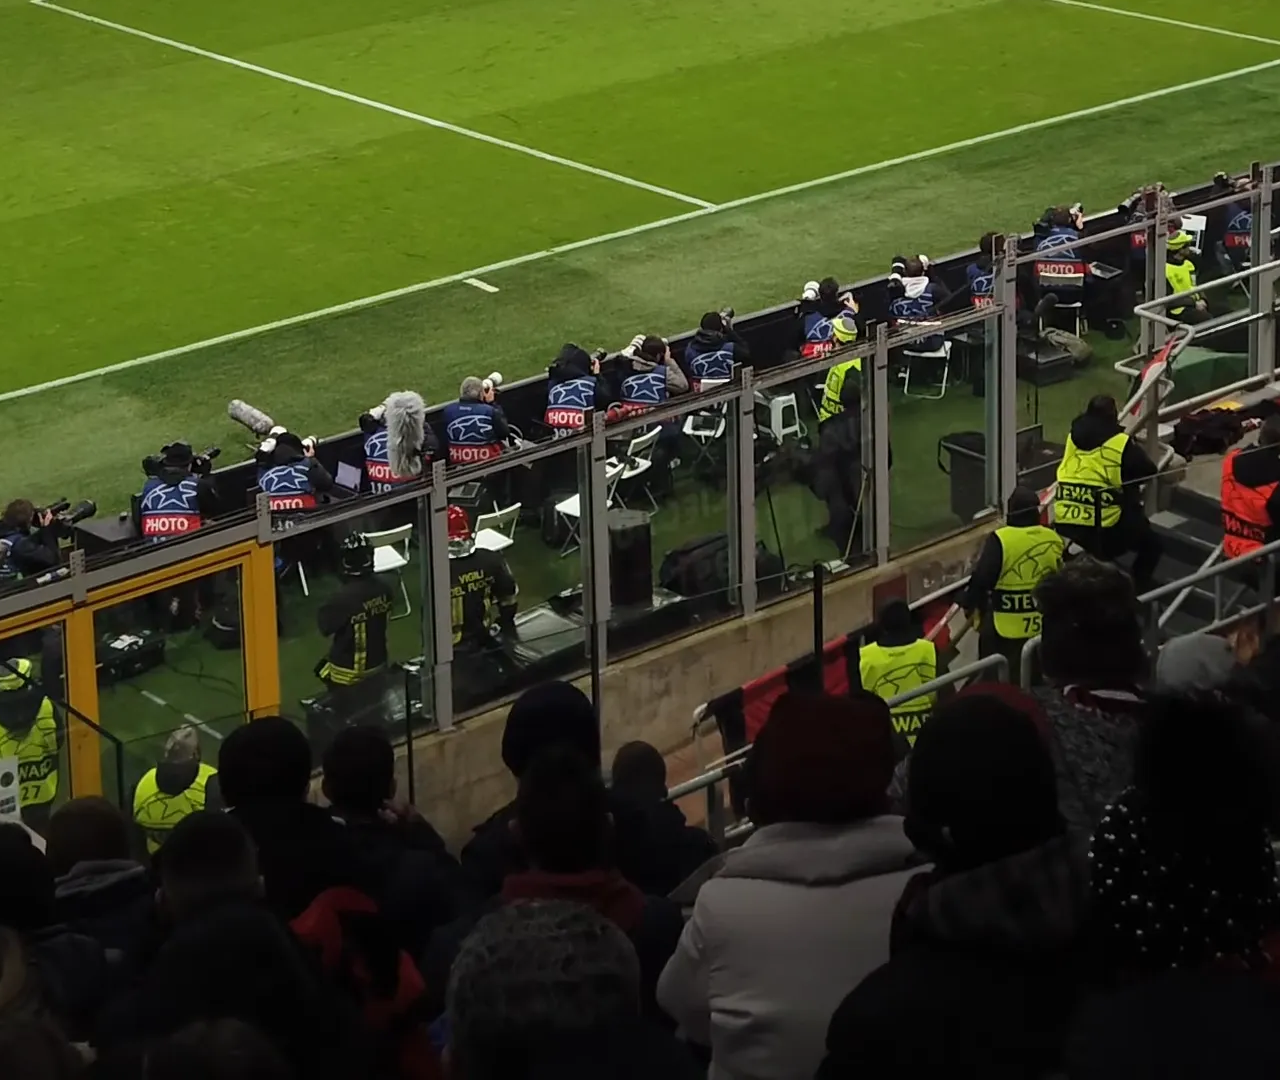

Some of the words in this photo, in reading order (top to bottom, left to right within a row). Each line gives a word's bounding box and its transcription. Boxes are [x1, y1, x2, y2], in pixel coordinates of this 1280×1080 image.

[1038, 263, 1075, 275] PHOTO
[1062, 504, 1093, 520] 705
[145, 517, 189, 532] PHOTO
